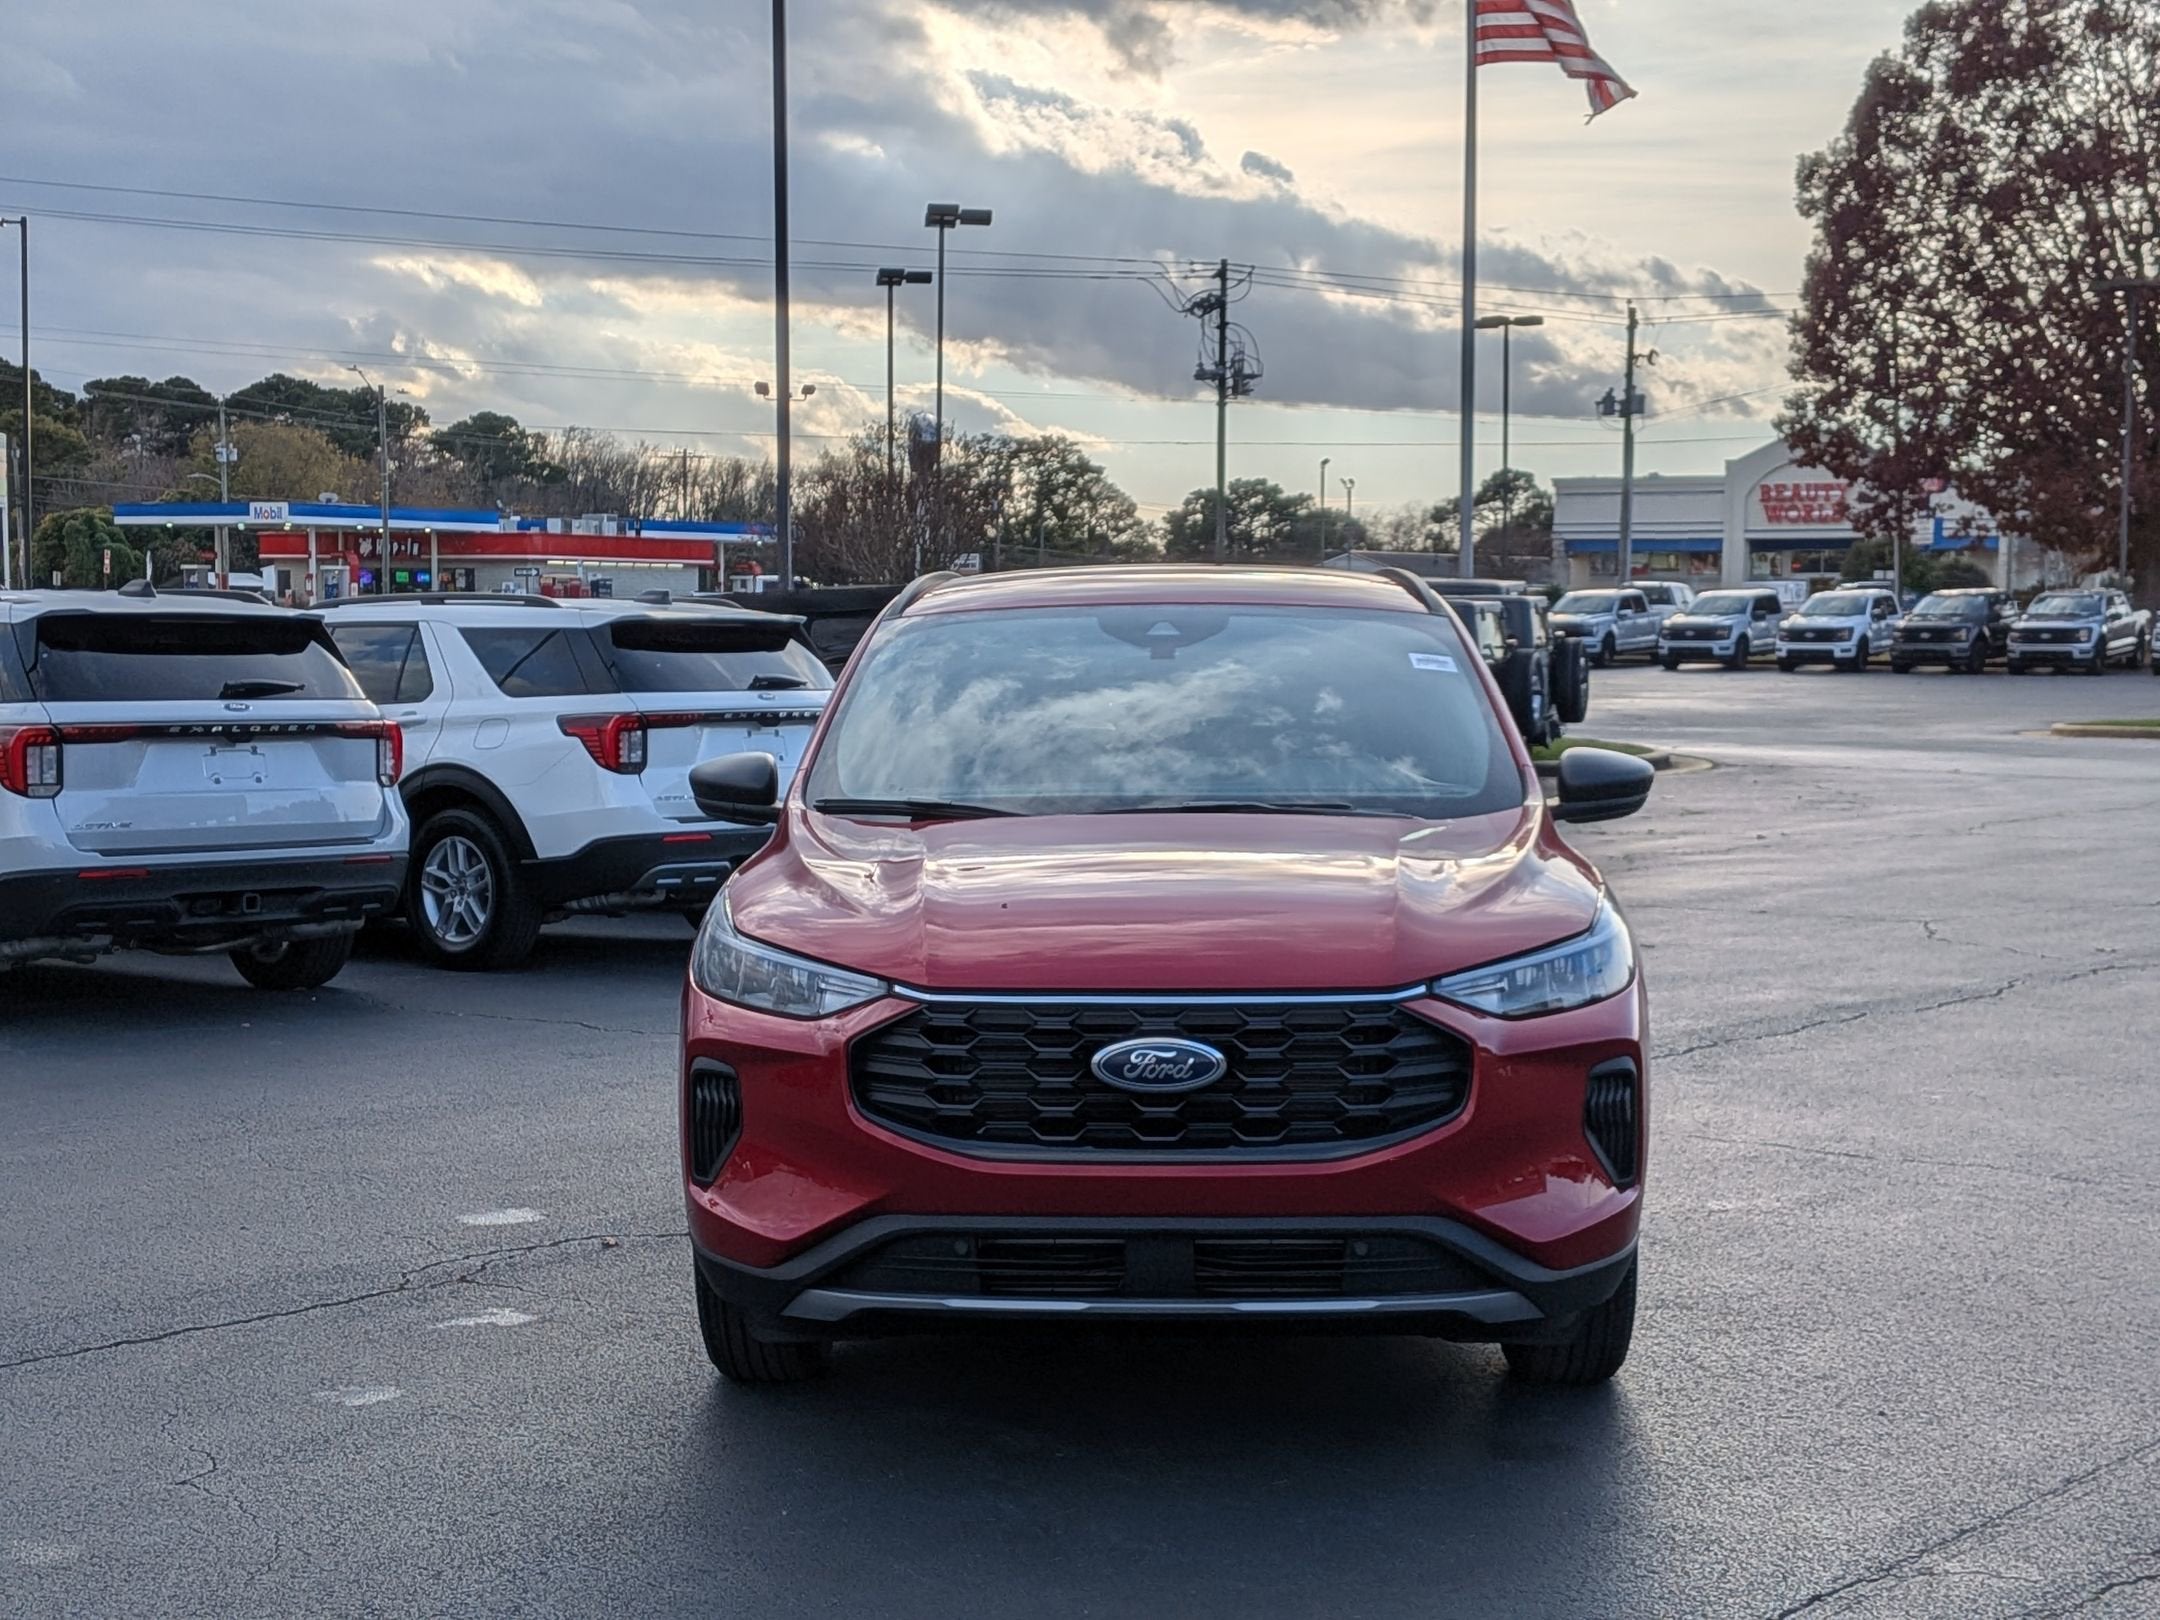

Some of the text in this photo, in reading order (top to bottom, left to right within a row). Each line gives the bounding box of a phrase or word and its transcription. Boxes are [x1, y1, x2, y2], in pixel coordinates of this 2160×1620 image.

[1760, 483, 1848, 502] BEAUTY
[254, 506, 282, 520] Mobil
[168, 720, 317, 732] EXPLORER
[1123, 1049, 1195, 1080] Ford
